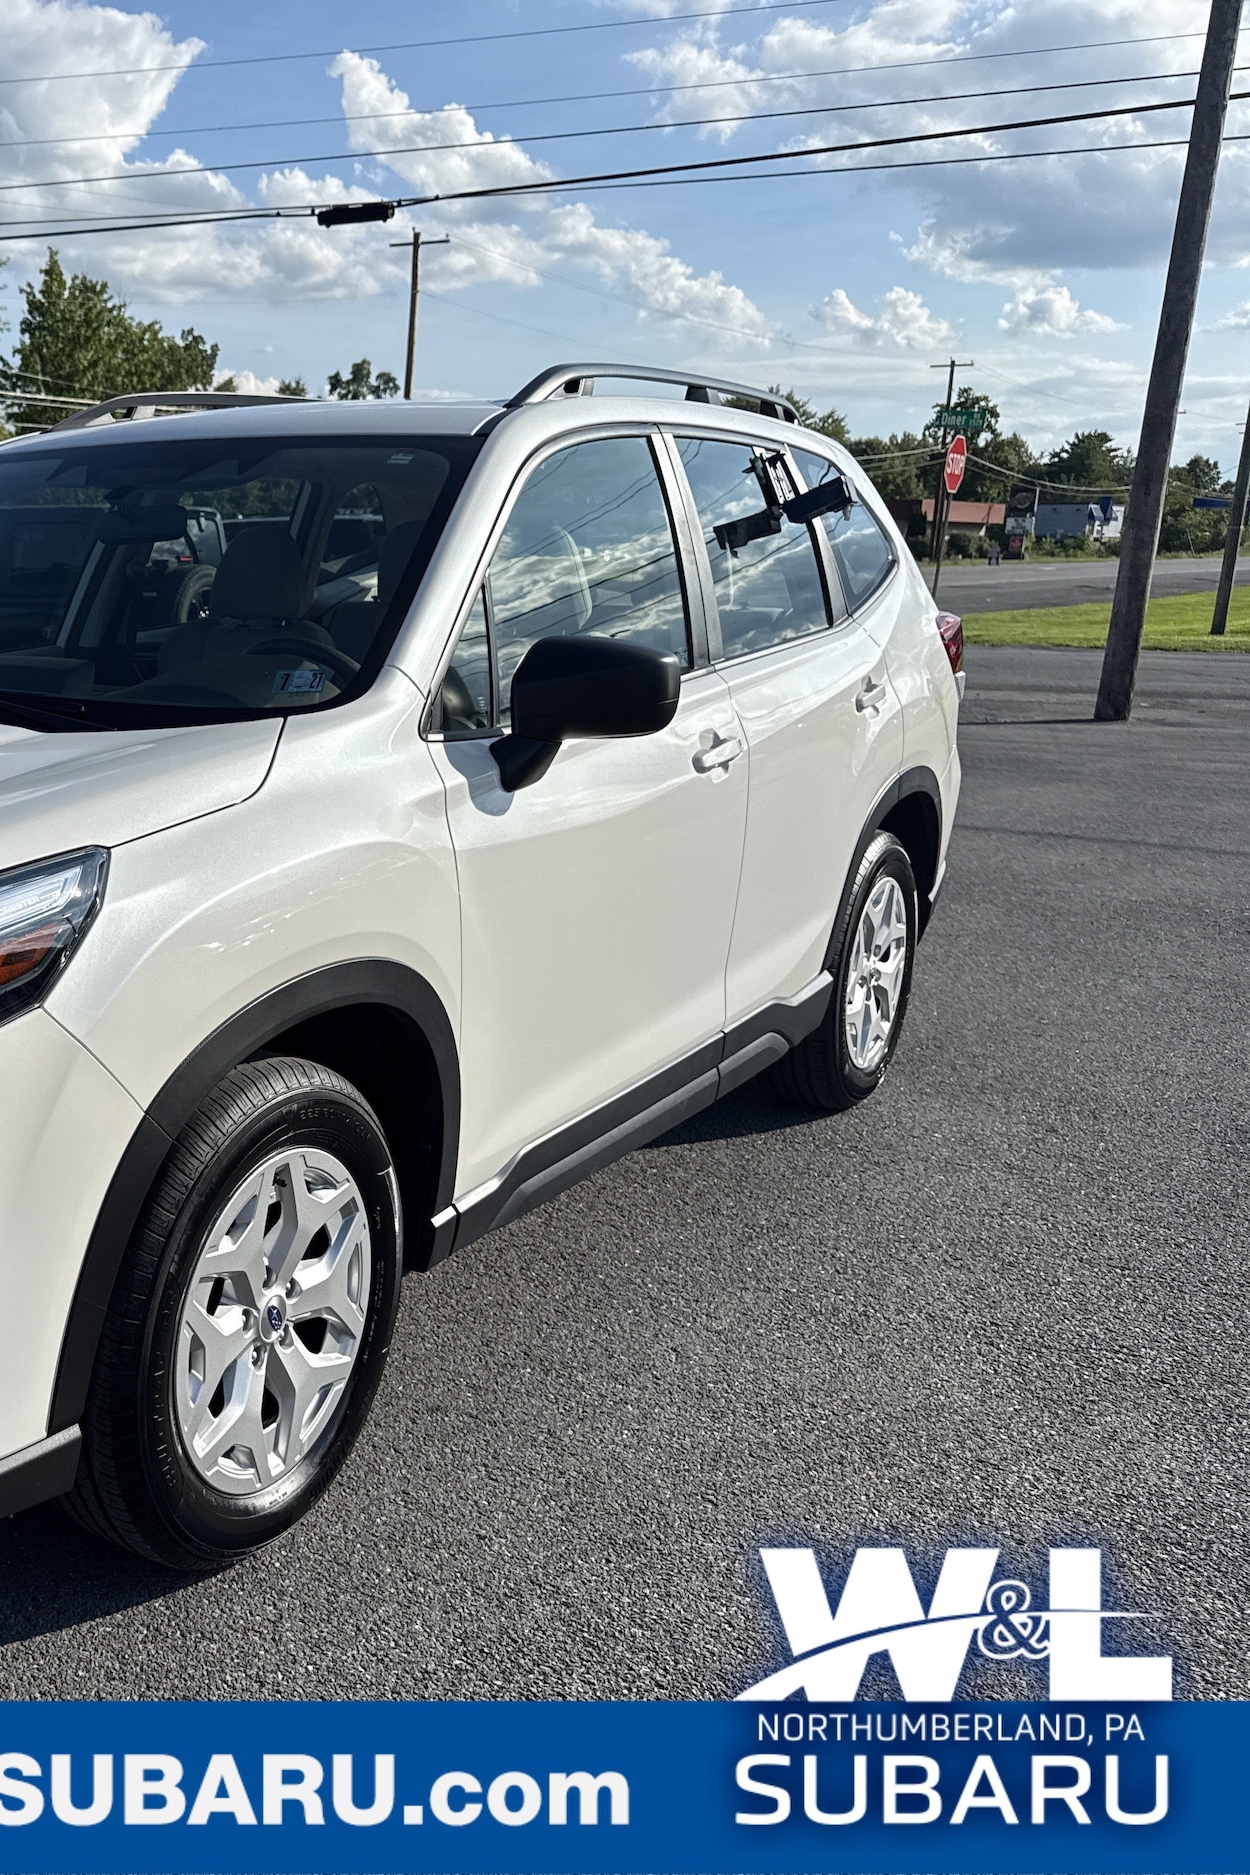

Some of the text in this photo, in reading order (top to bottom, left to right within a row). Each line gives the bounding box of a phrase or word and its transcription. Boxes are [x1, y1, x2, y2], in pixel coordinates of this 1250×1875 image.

[941, 412, 967, 426] Diner
[946, 453, 965, 475] STOP
[280, 672, 324, 690] 7 27
